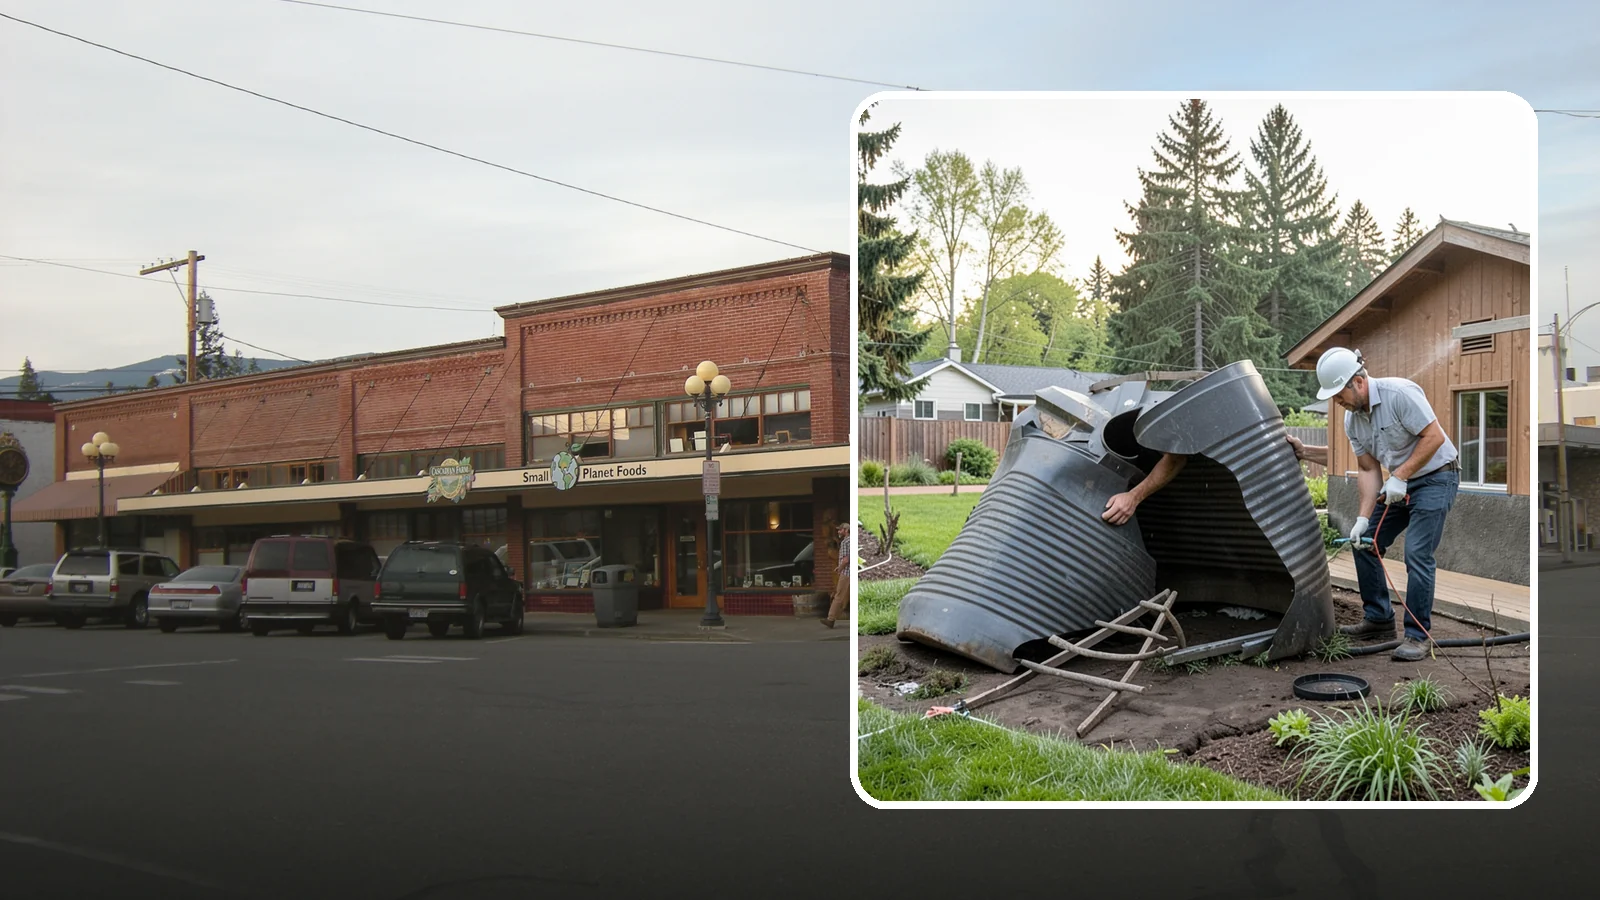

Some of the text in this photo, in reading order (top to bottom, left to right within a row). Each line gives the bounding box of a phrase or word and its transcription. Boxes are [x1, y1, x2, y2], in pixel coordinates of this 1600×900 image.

[523, 464, 647, 483] Small Planet Foods
